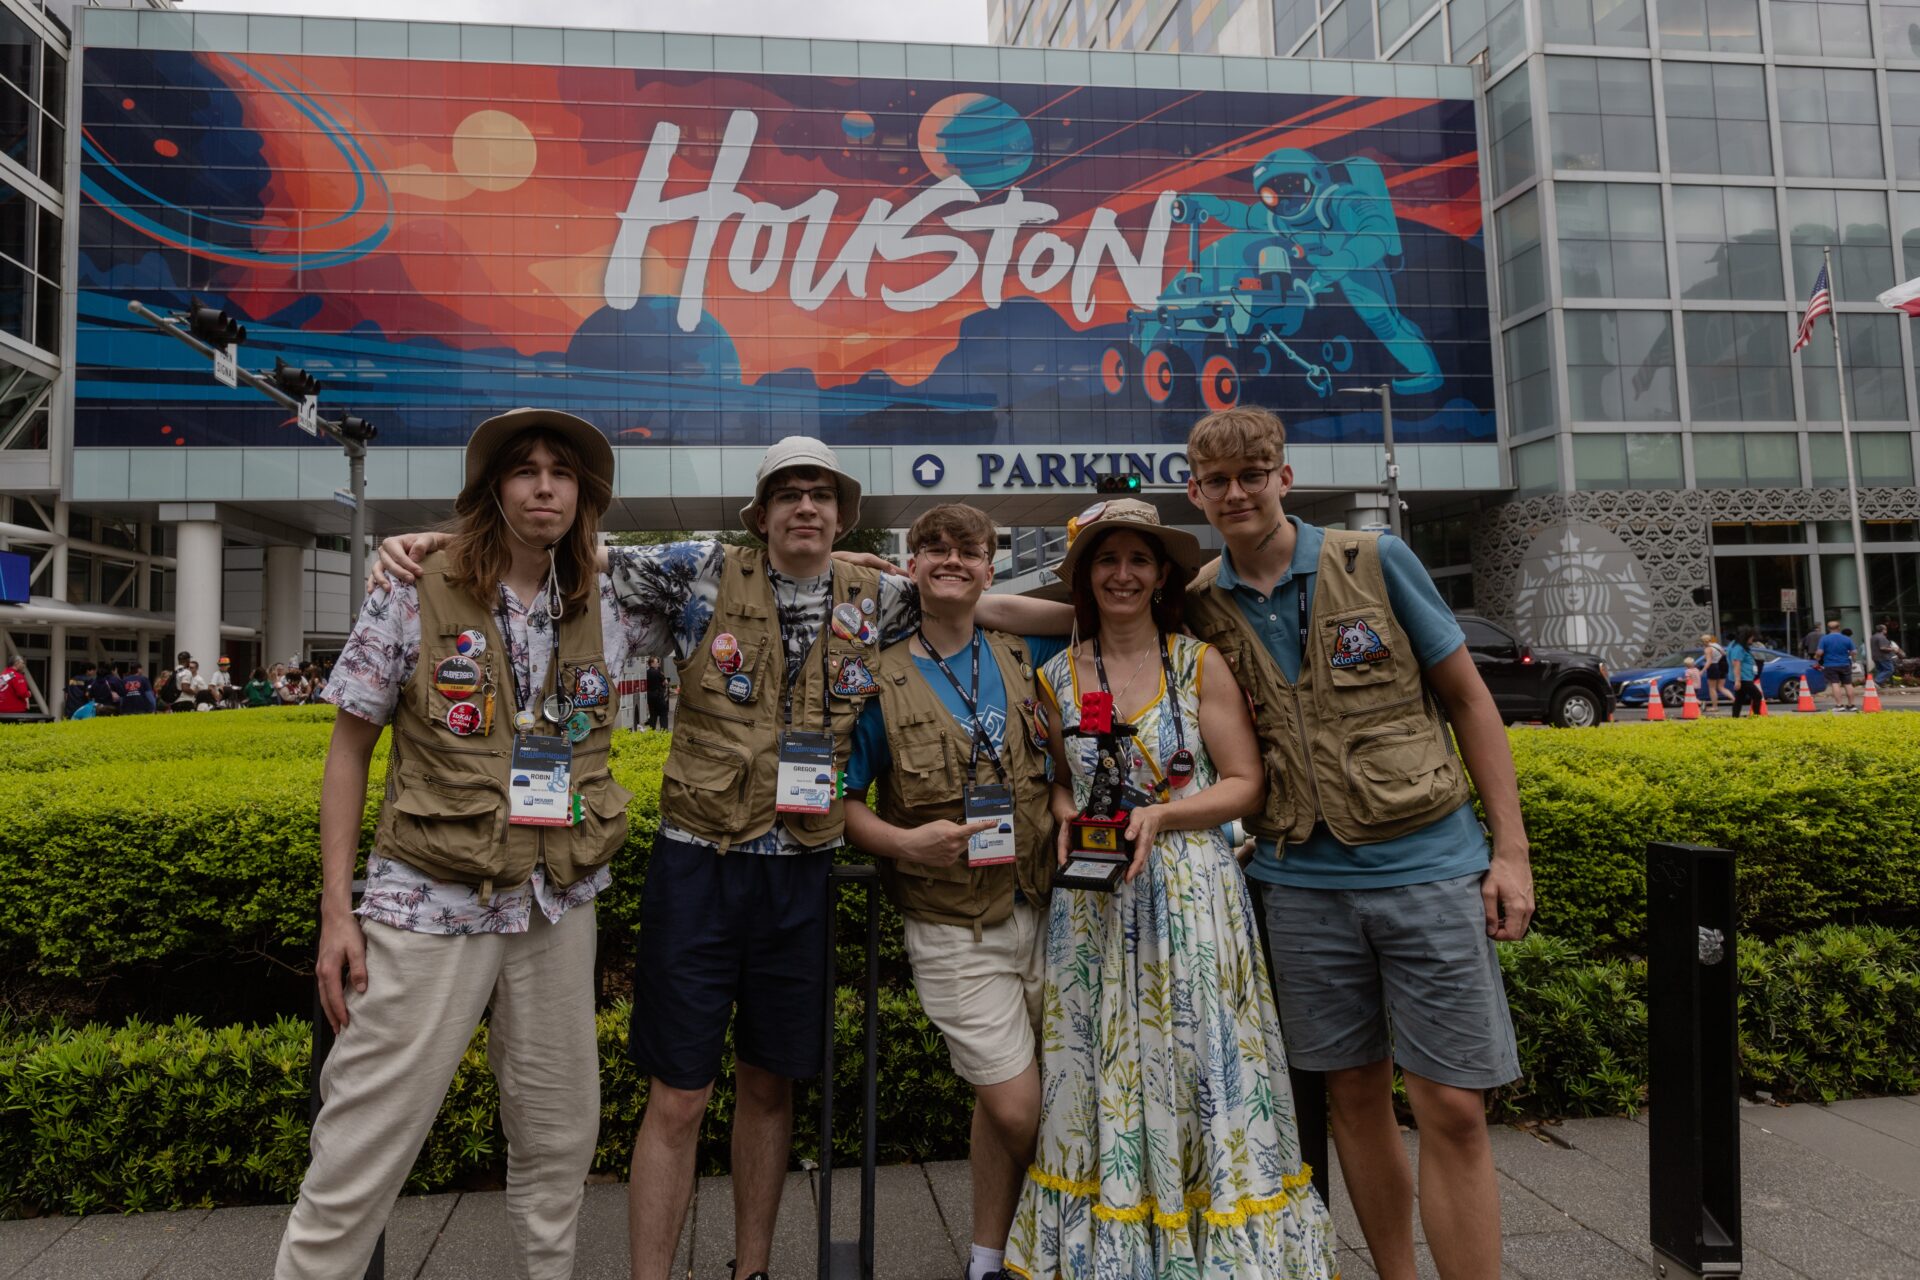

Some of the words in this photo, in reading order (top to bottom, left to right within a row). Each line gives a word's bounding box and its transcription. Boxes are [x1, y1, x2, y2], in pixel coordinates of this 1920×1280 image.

[217, 361, 235, 381] SIGNAL
[977, 452, 1190, 488] PARKING
[1332, 649, 1388, 665] KlotsiGuru
[834, 684, 880, 694] KlotsiGuru
